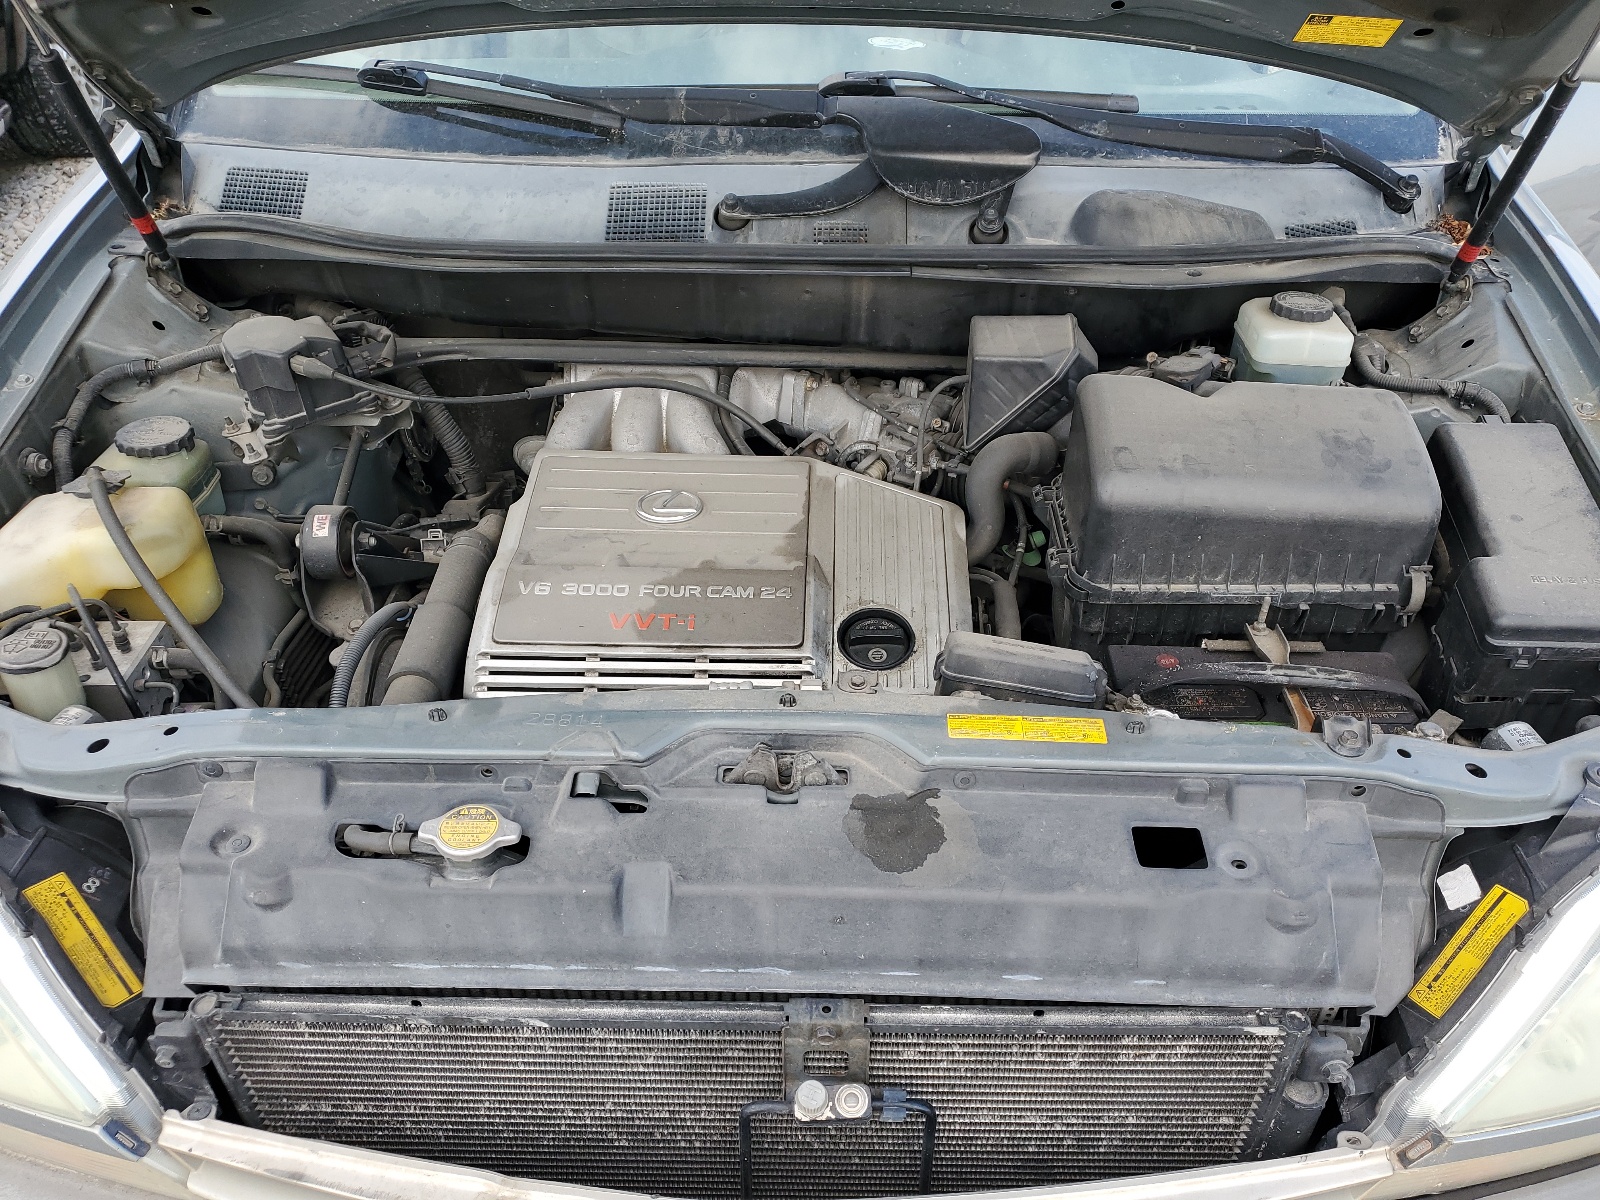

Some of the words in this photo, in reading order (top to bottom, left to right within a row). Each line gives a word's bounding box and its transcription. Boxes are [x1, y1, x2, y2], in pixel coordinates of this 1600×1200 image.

[518, 580, 552, 595] V6
[561, 583, 630, 597] 3000
[639, 584, 702, 598] FOUR
[706, 585, 754, 599] CAM
[759, 586, 793, 599] 24
[609, 612, 696, 631] VVT-i
[525, 712, 603, 728] 28814
